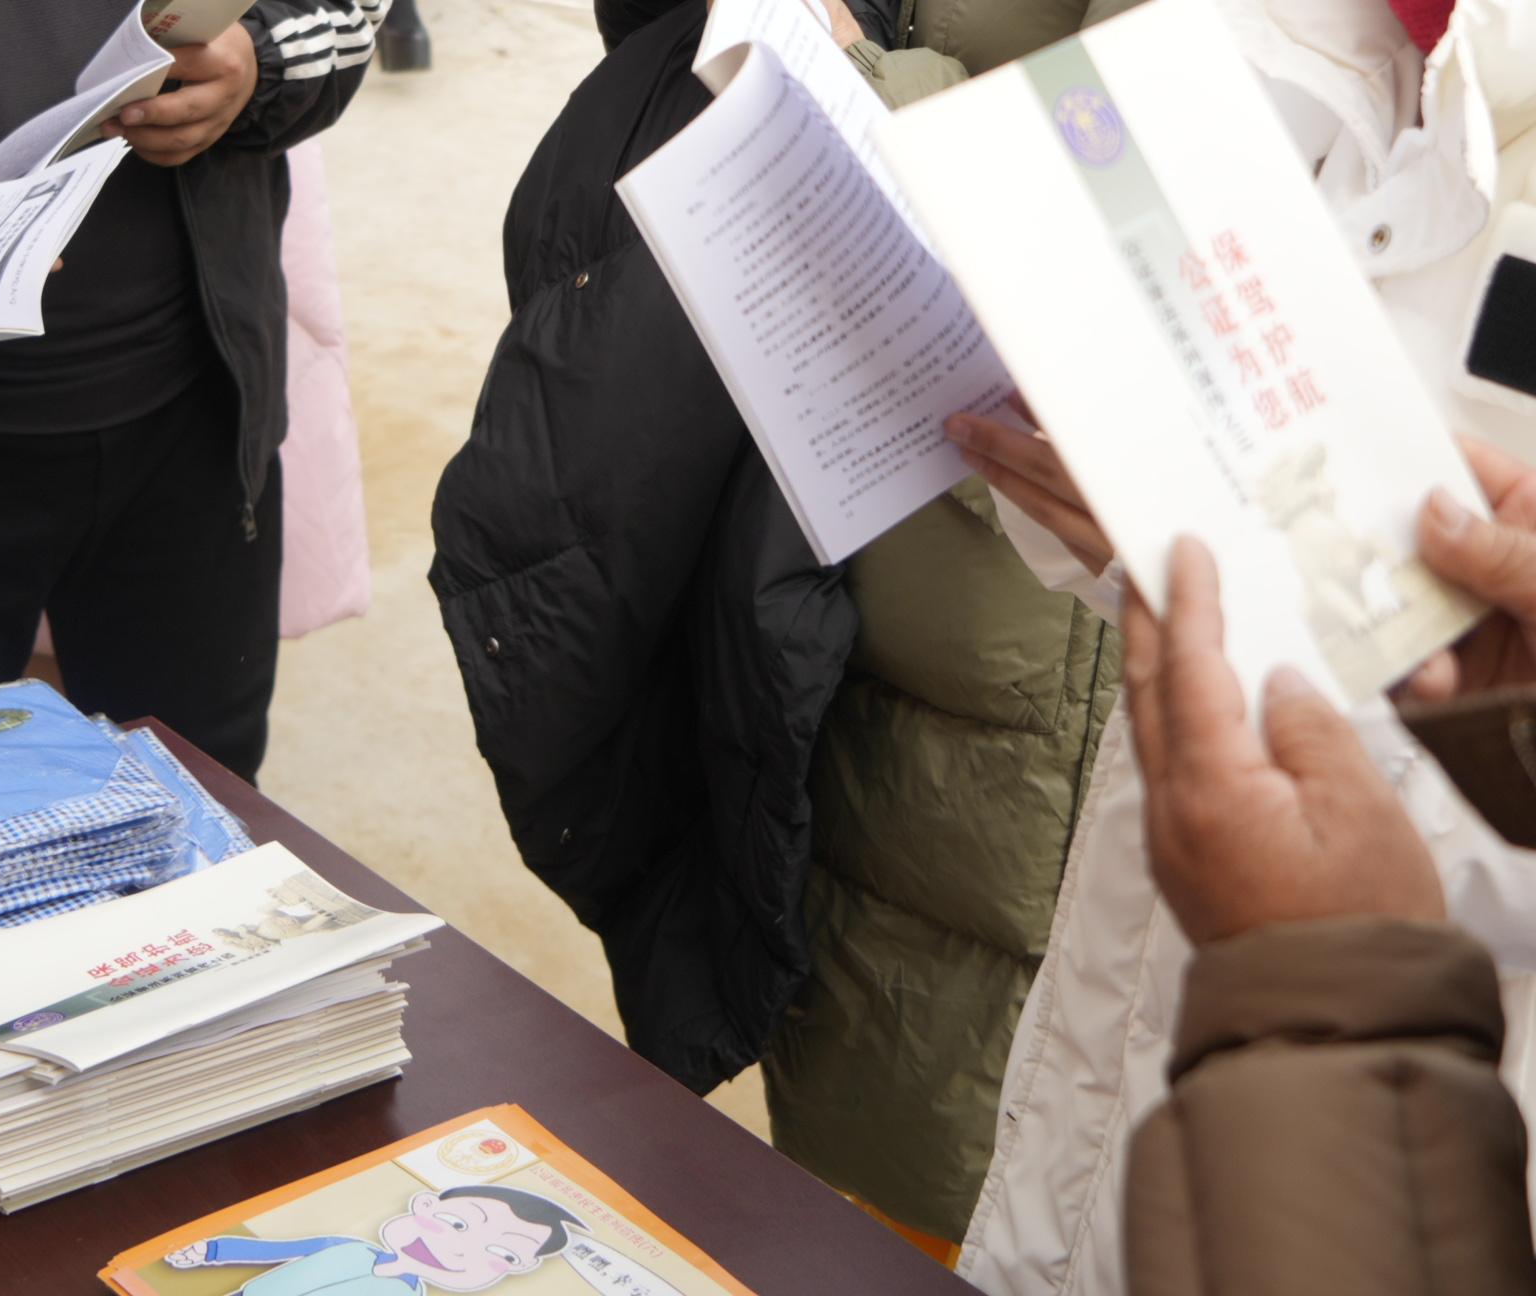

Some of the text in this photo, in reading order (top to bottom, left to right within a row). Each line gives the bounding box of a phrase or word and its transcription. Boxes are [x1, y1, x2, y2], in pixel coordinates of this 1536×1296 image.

[1177, 249, 1290, 432] 公证为您
[1210, 227, 1328, 417] 保驾护航
[87, 928, 200, 980] 保驾护航
[107, 941, 216, 989] 公证为您
